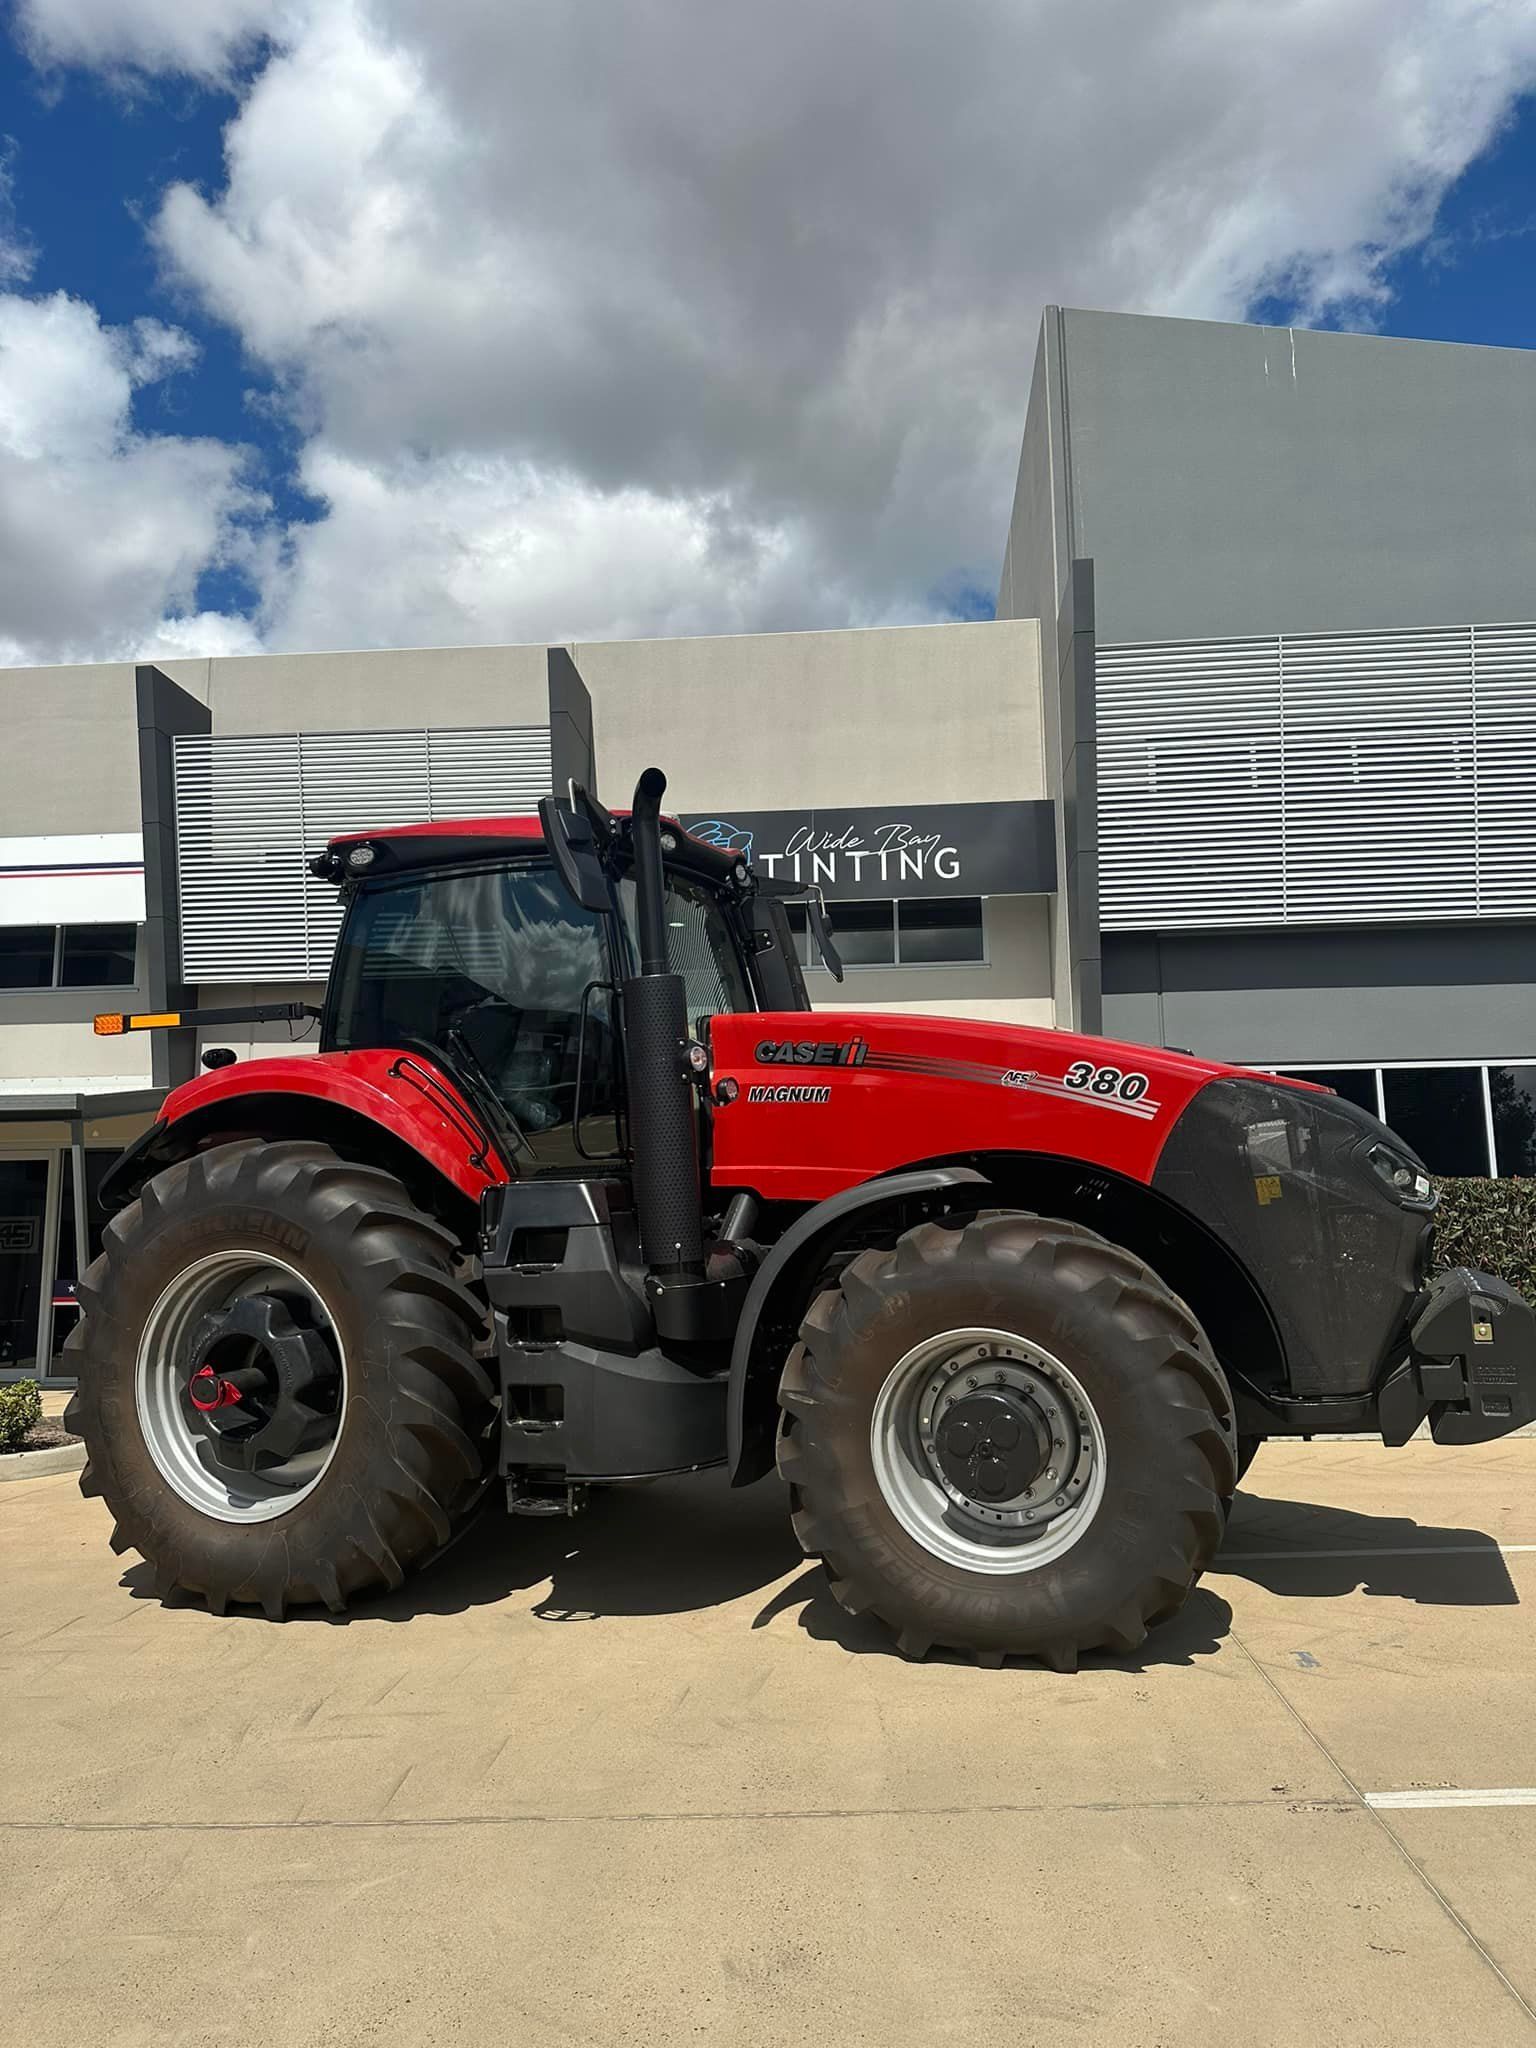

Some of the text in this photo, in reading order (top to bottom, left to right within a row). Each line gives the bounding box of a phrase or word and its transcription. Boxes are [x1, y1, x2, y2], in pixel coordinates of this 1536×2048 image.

[785, 823, 942, 864] Wide Bay
[758, 846, 961, 884] TINTING
[755, 1040, 837, 1064] CASE
[747, 1085, 832, 1104] MAGNUM
[1063, 1060, 1150, 1103] 380
